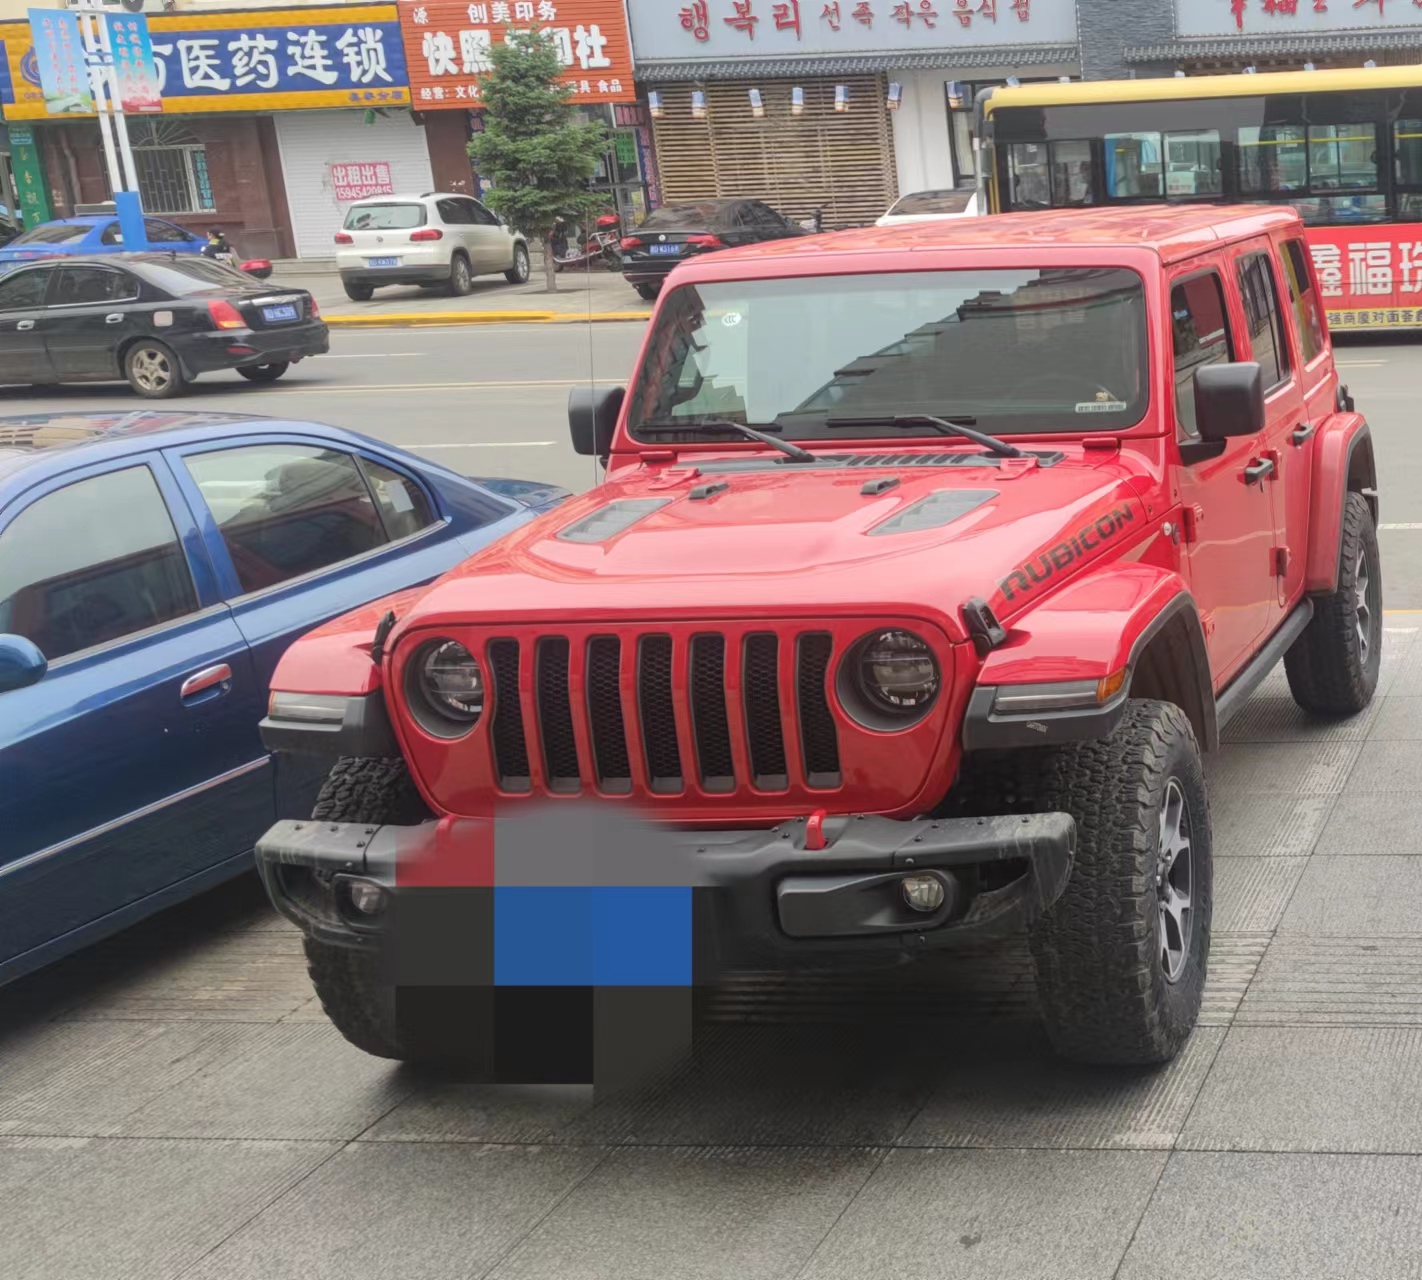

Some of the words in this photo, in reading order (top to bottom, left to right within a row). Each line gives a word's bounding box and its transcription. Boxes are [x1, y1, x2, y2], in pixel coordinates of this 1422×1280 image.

[467, 2, 557, 24] 创美印务
[677, 0, 801, 42] 행복리
[422, 24, 611, 76] 快照印社
[333, 165, 390, 185] 出租出售
[1000, 503, 1134, 601] RUBICON
